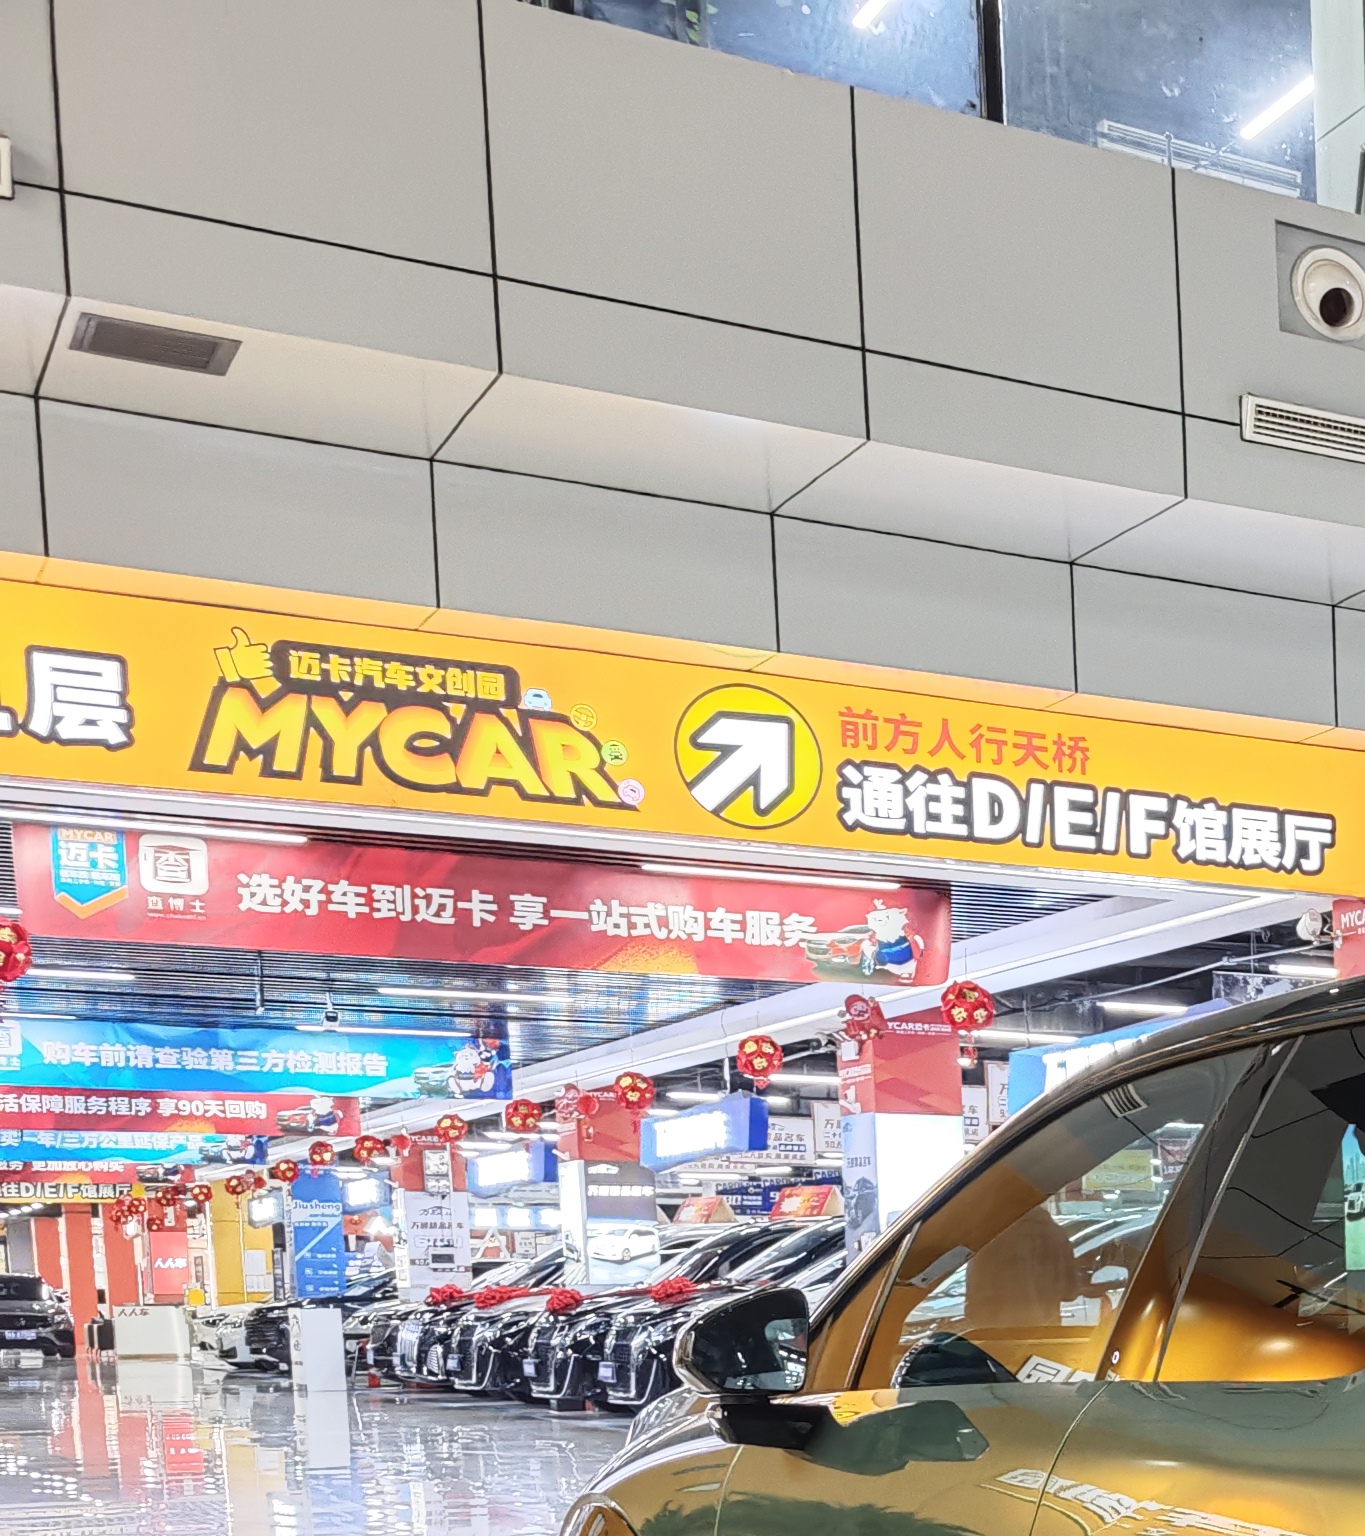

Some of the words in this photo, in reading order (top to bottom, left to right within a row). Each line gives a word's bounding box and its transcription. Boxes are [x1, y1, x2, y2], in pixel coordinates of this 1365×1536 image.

[0, 645, 134, 752] 层
[288, 649, 508, 702] 迈卡汽车文创园
[195, 684, 630, 812] MYCAR
[838, 705, 1090, 776] 前方人行天桥
[836, 758, 1338, 876] 通往D/E/F馆展厅
[57, 840, 120, 870] 迈卡
[236, 873, 498, 928] 选好车到迈卡
[509, 896, 818, 949] 享一站式购车服务
[42, 1040, 389, 1078] 购车前请查验第三方检测报告
[156, 1097, 267, 1121] 享90天回购
[0, 1182, 131, 1199] 往D/E/F馆展厅
